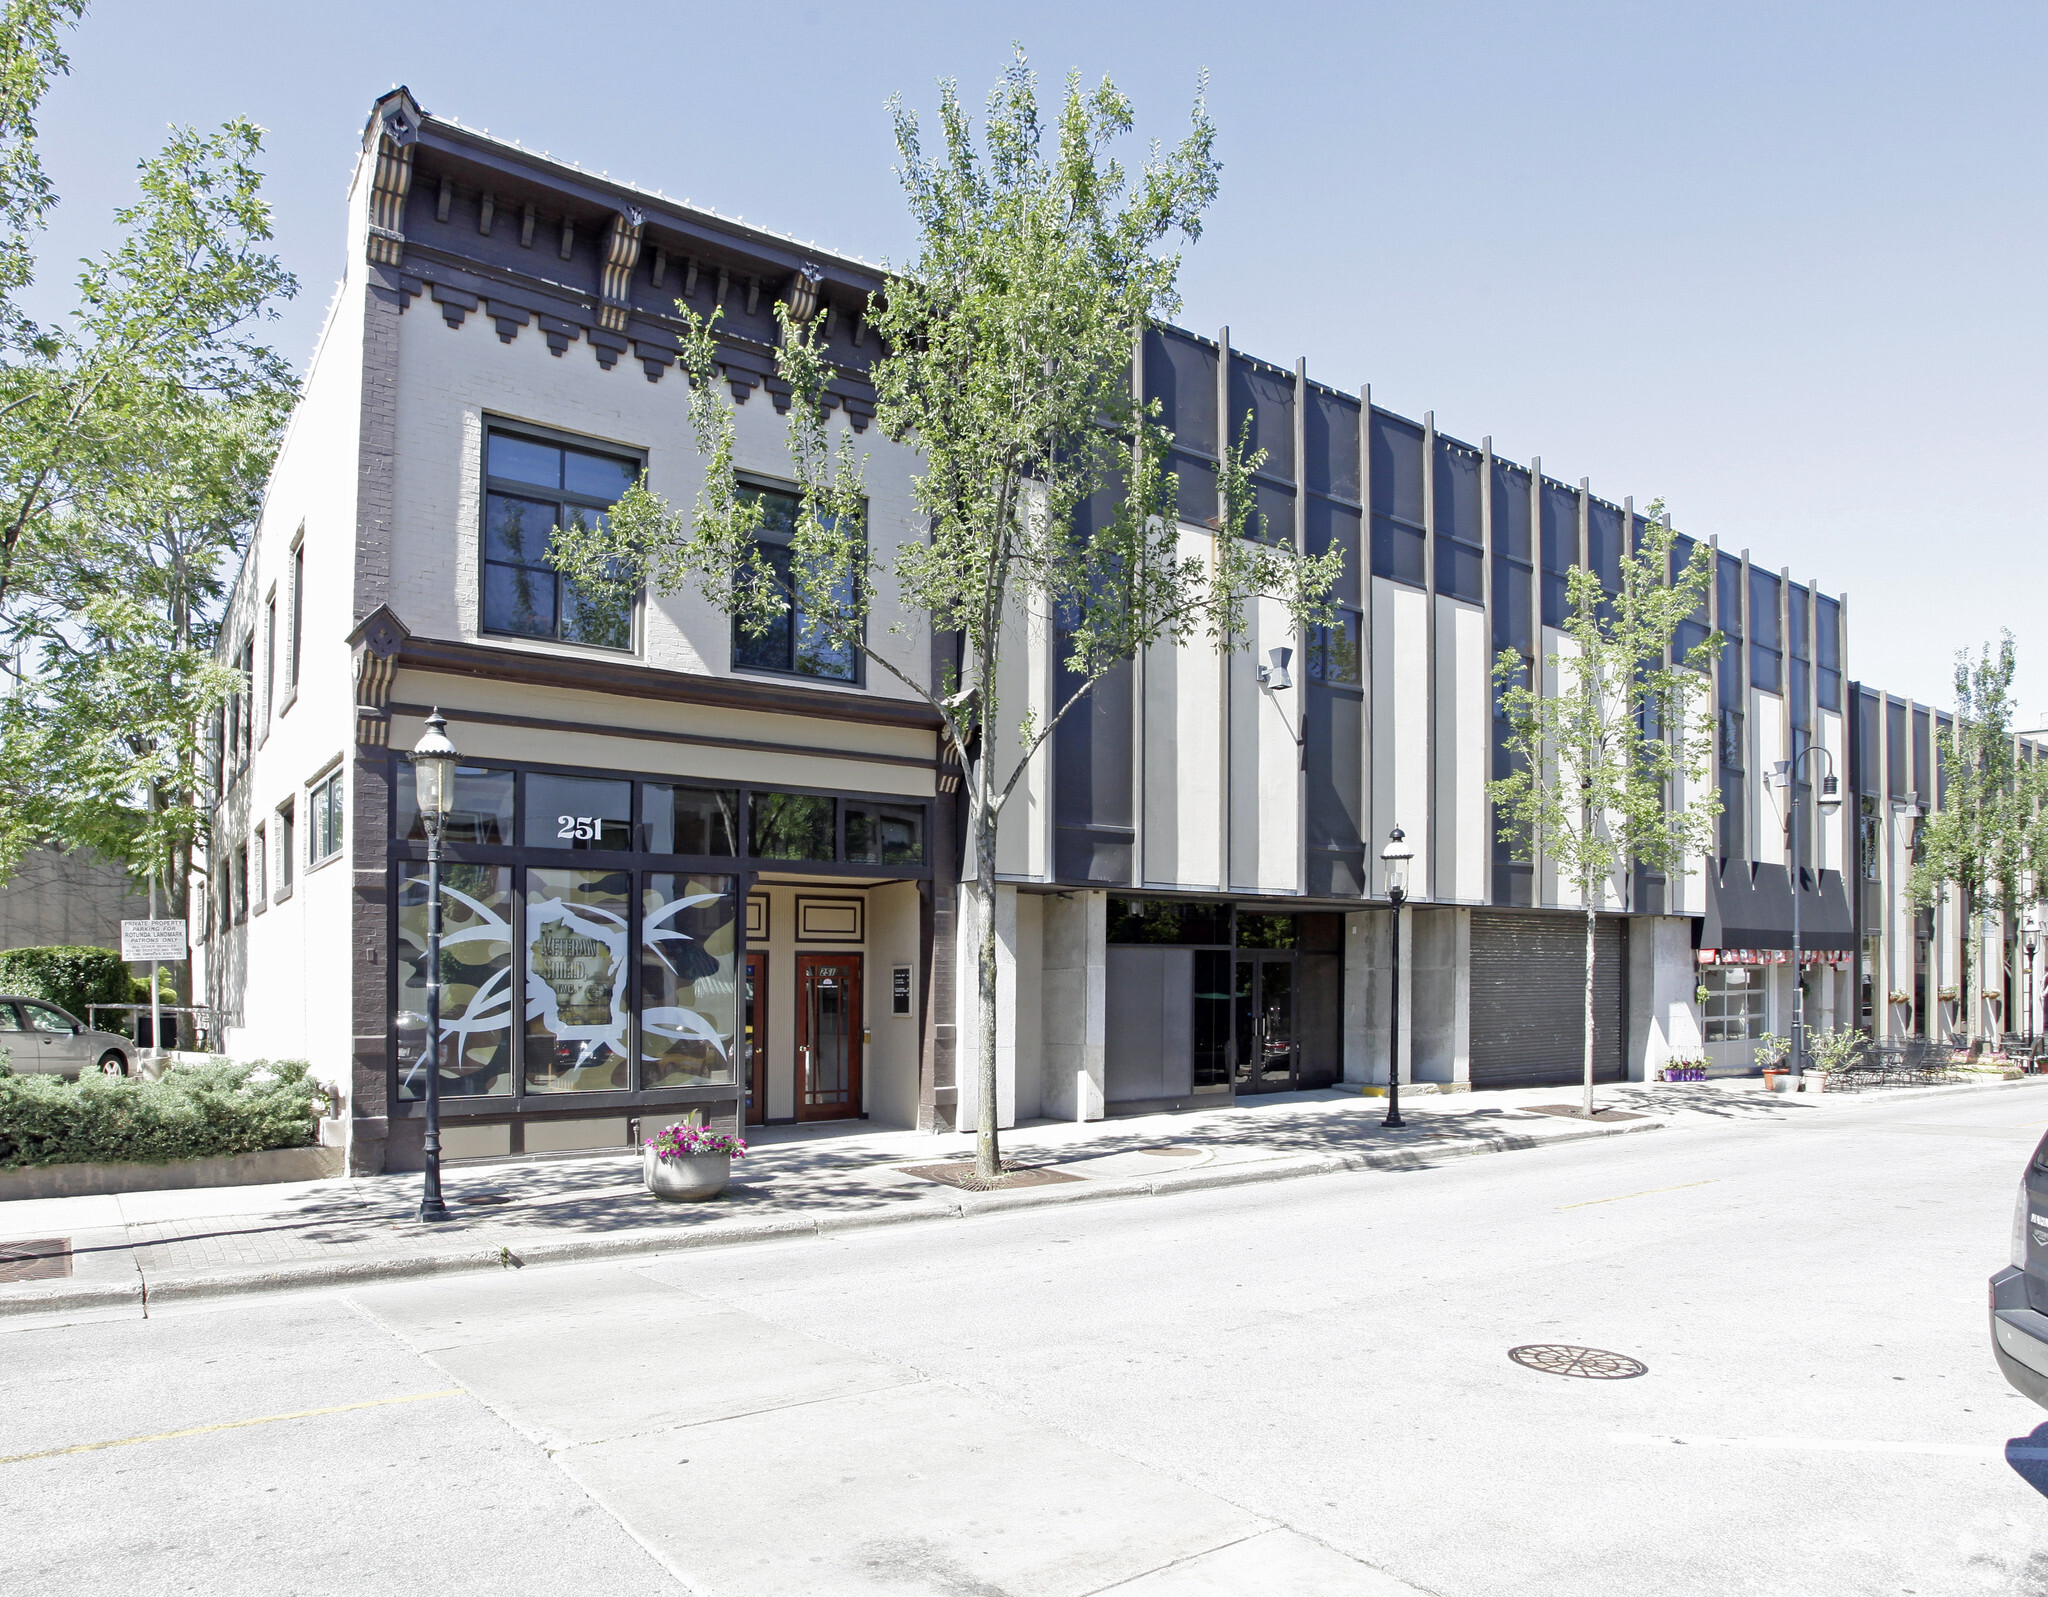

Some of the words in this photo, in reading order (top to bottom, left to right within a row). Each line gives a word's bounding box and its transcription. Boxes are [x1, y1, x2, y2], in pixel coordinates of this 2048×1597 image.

[558, 815, 602, 840] 251
[541, 936, 597, 957] VETERAN
[820, 967, 836, 976] 251
